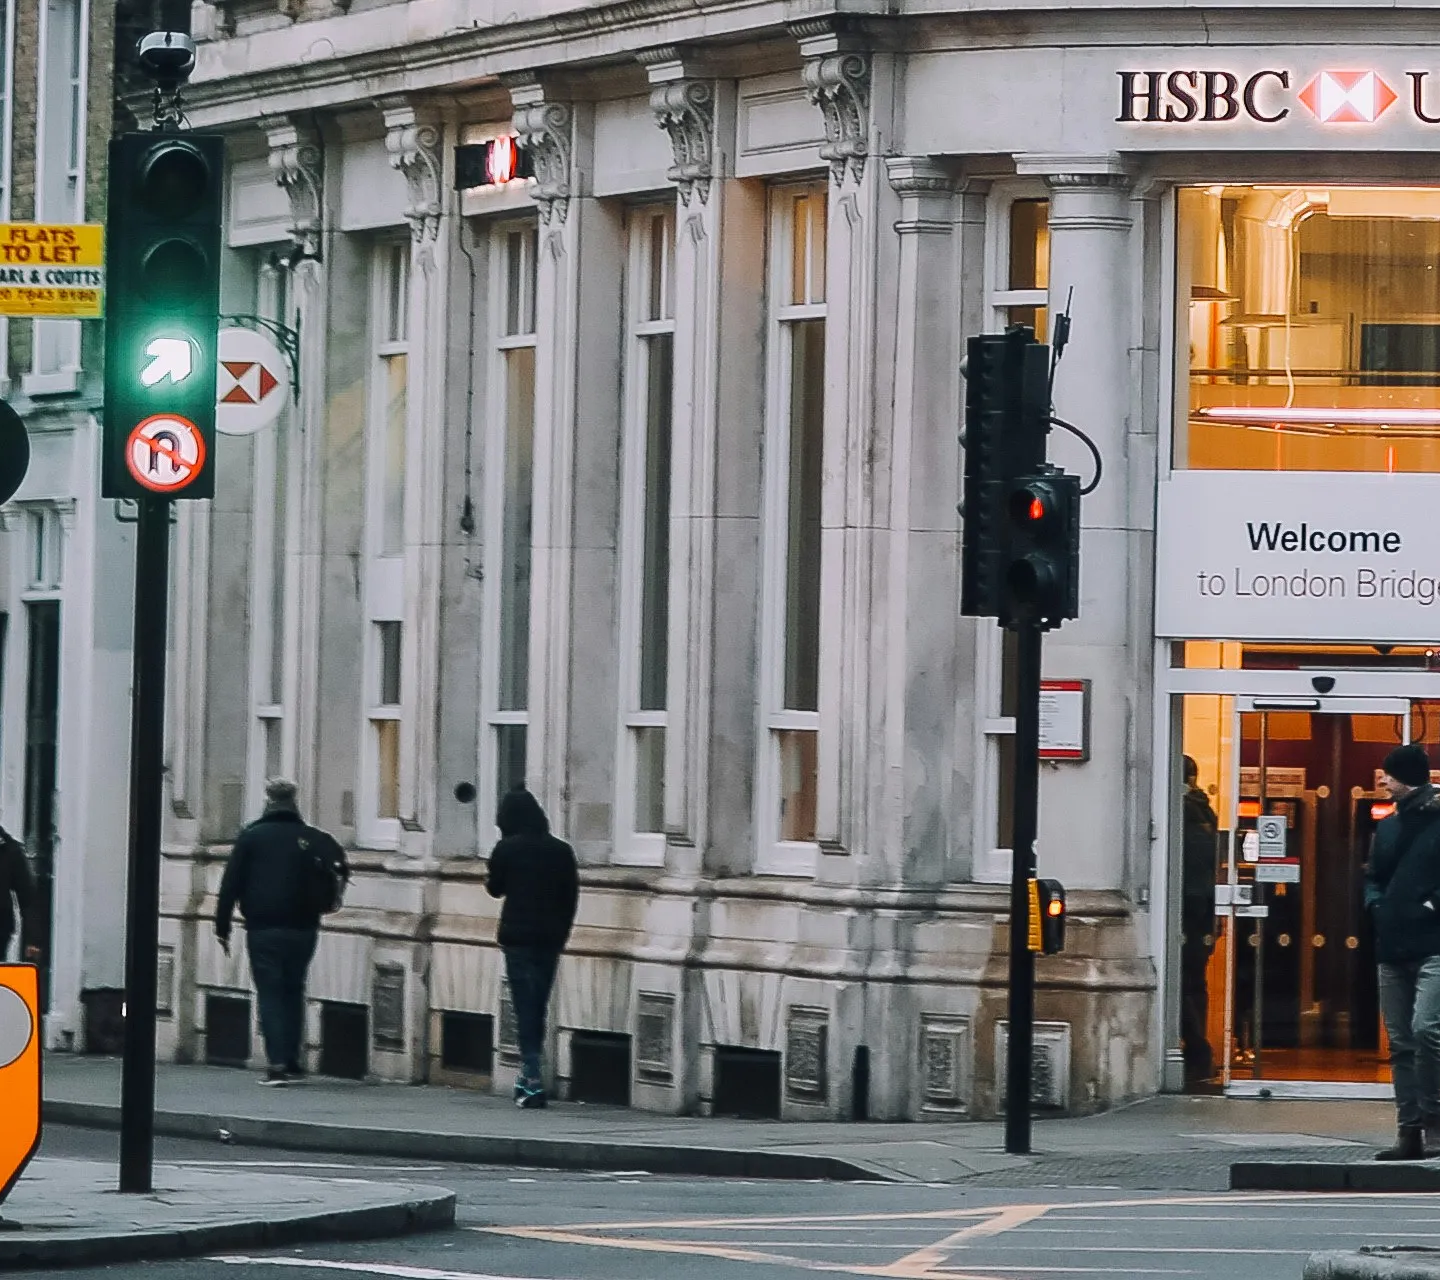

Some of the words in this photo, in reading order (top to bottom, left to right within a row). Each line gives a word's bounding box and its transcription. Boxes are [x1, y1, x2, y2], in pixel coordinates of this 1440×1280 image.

[1116, 70, 1291, 124] HSBC
[9, 228, 76, 244] FLATS
[2, 244, 31, 262] TO
[39, 245, 82, 262] LET
[30, 269, 40, 284] &
[45, 269, 101, 285] COUTTS
[1246, 522, 1401, 553] Welcome
[1197, 570, 1226, 597] to
[1235, 567, 1346, 598] London
